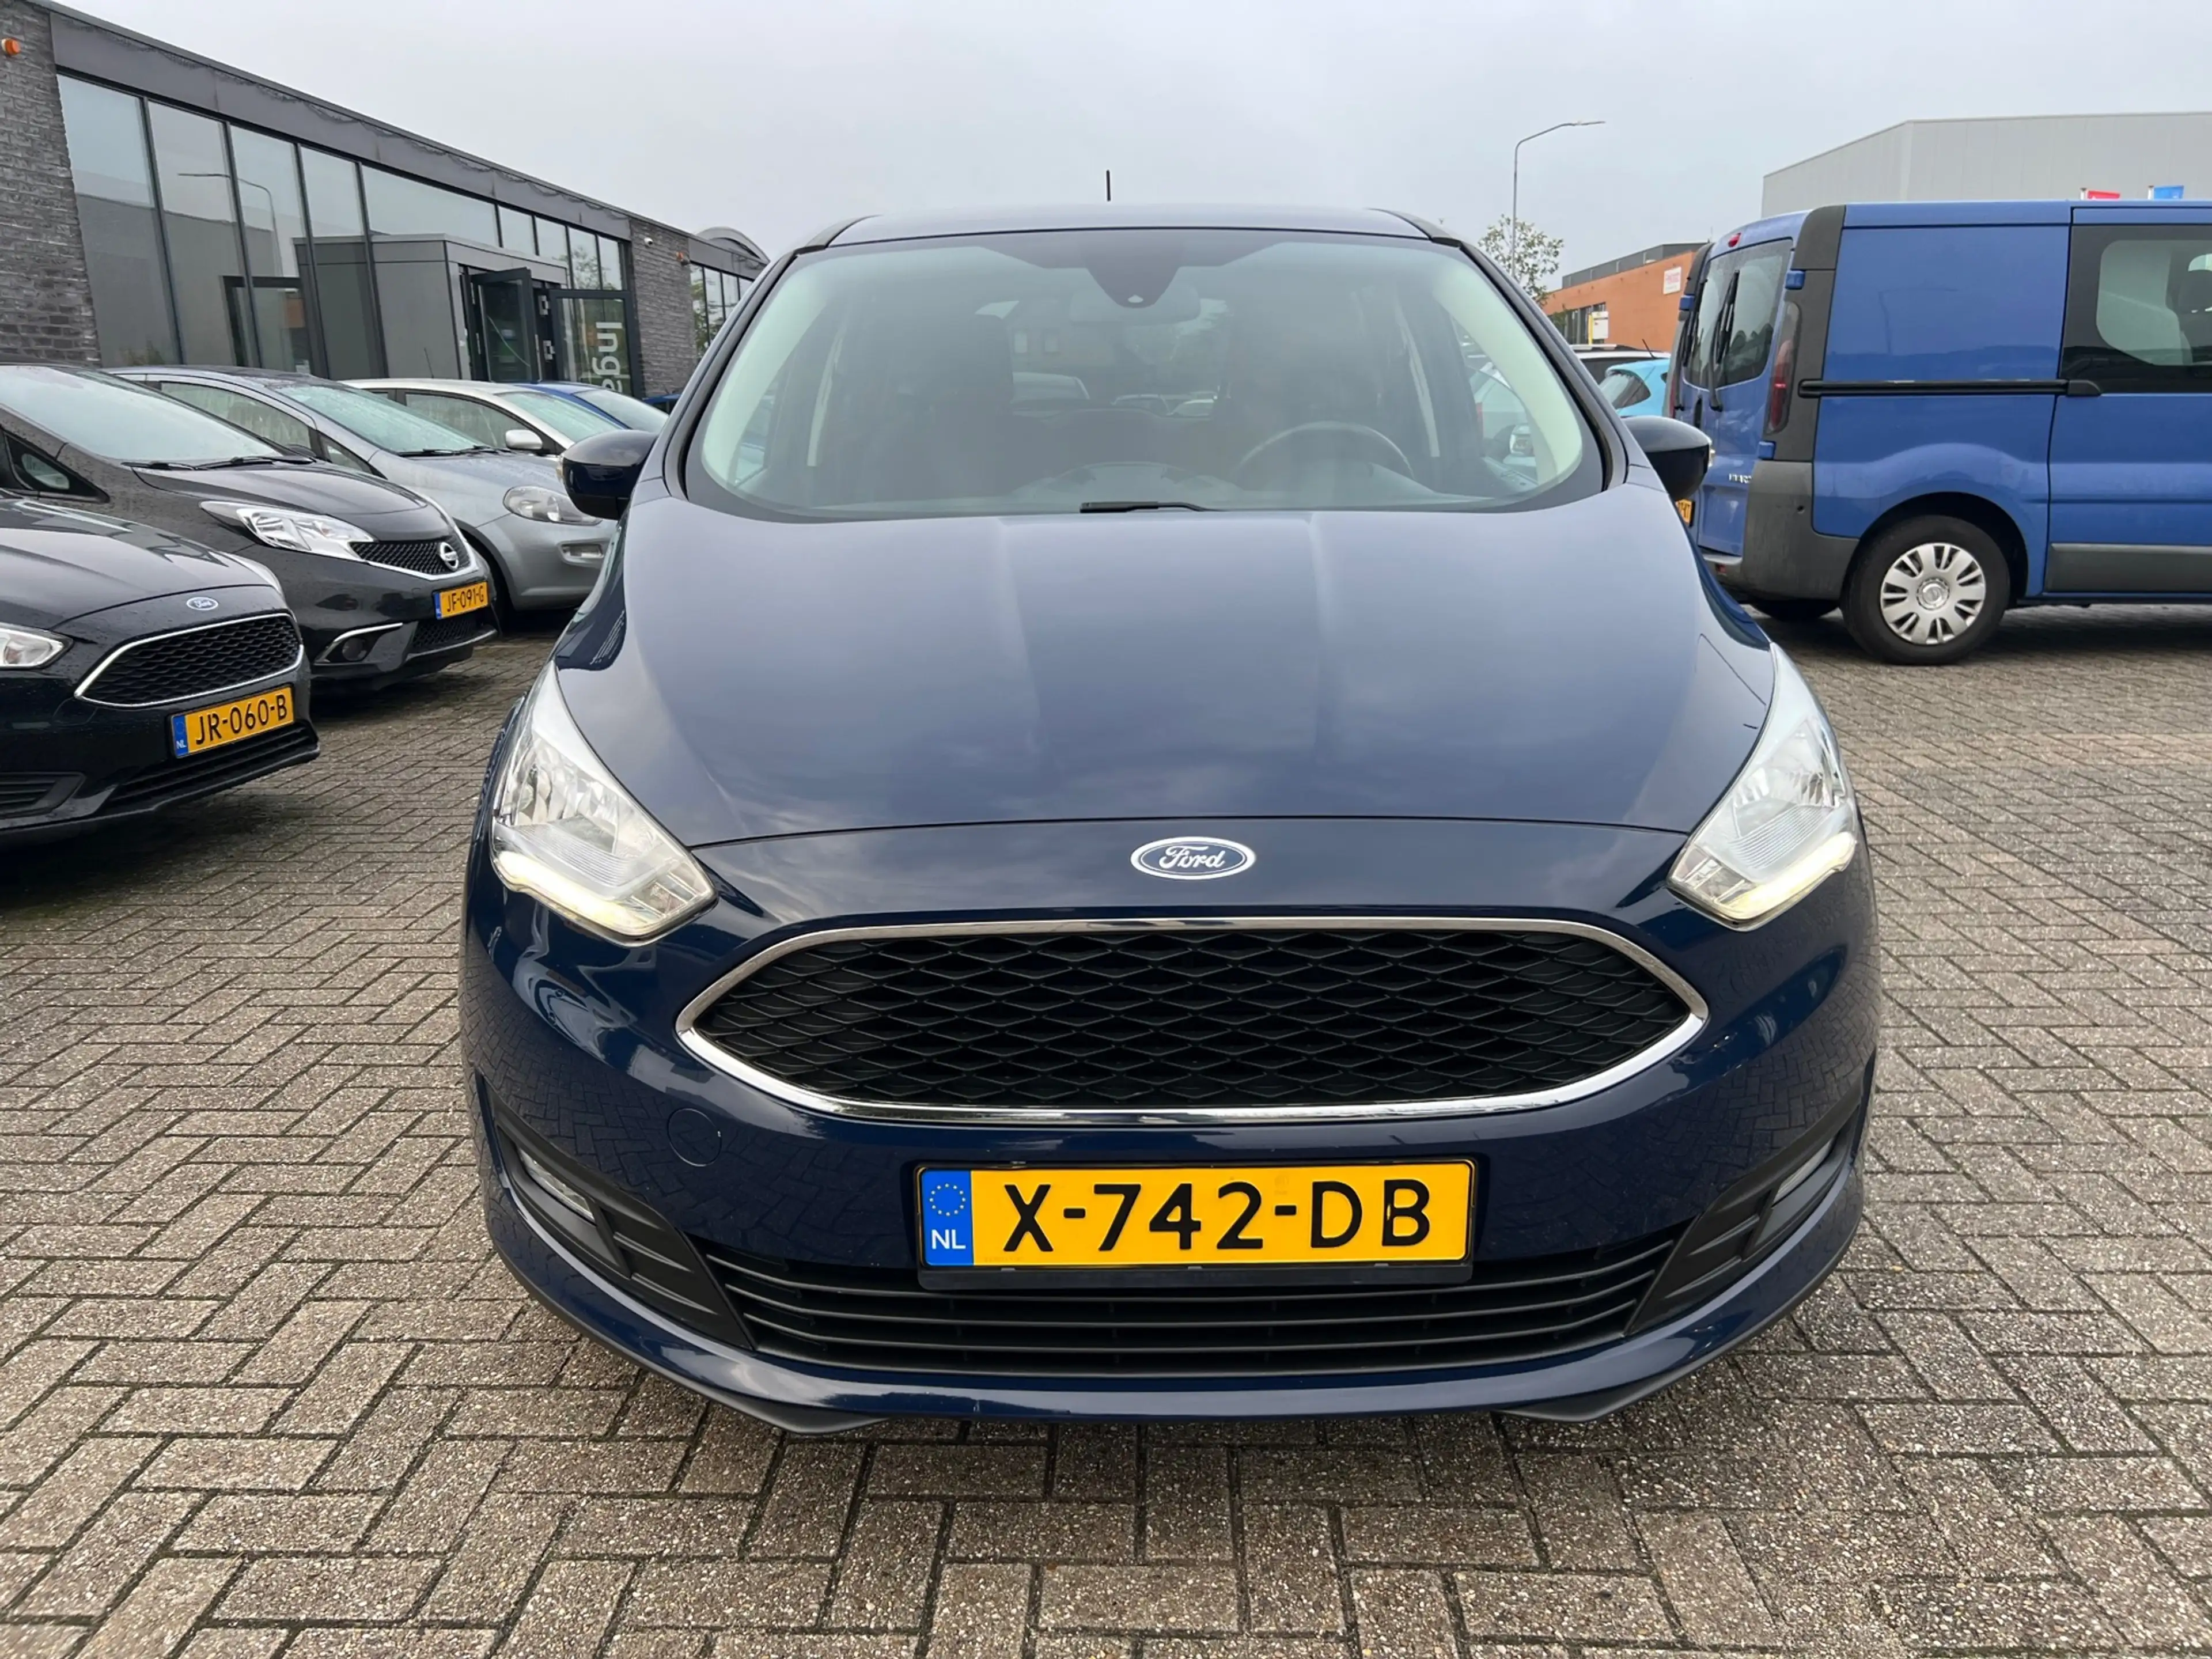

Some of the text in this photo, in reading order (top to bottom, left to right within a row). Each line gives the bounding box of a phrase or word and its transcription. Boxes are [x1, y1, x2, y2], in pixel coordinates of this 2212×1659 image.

[446, 585, 484, 612] JF-091-G
[195, 694, 287, 745] JR-060-B
[176, 739, 187, 749] NL
[1158, 845, 1226, 869] Ford
[1003, 1179, 1430, 1252] X-742-DB
[931, 1229, 966, 1250] NL
